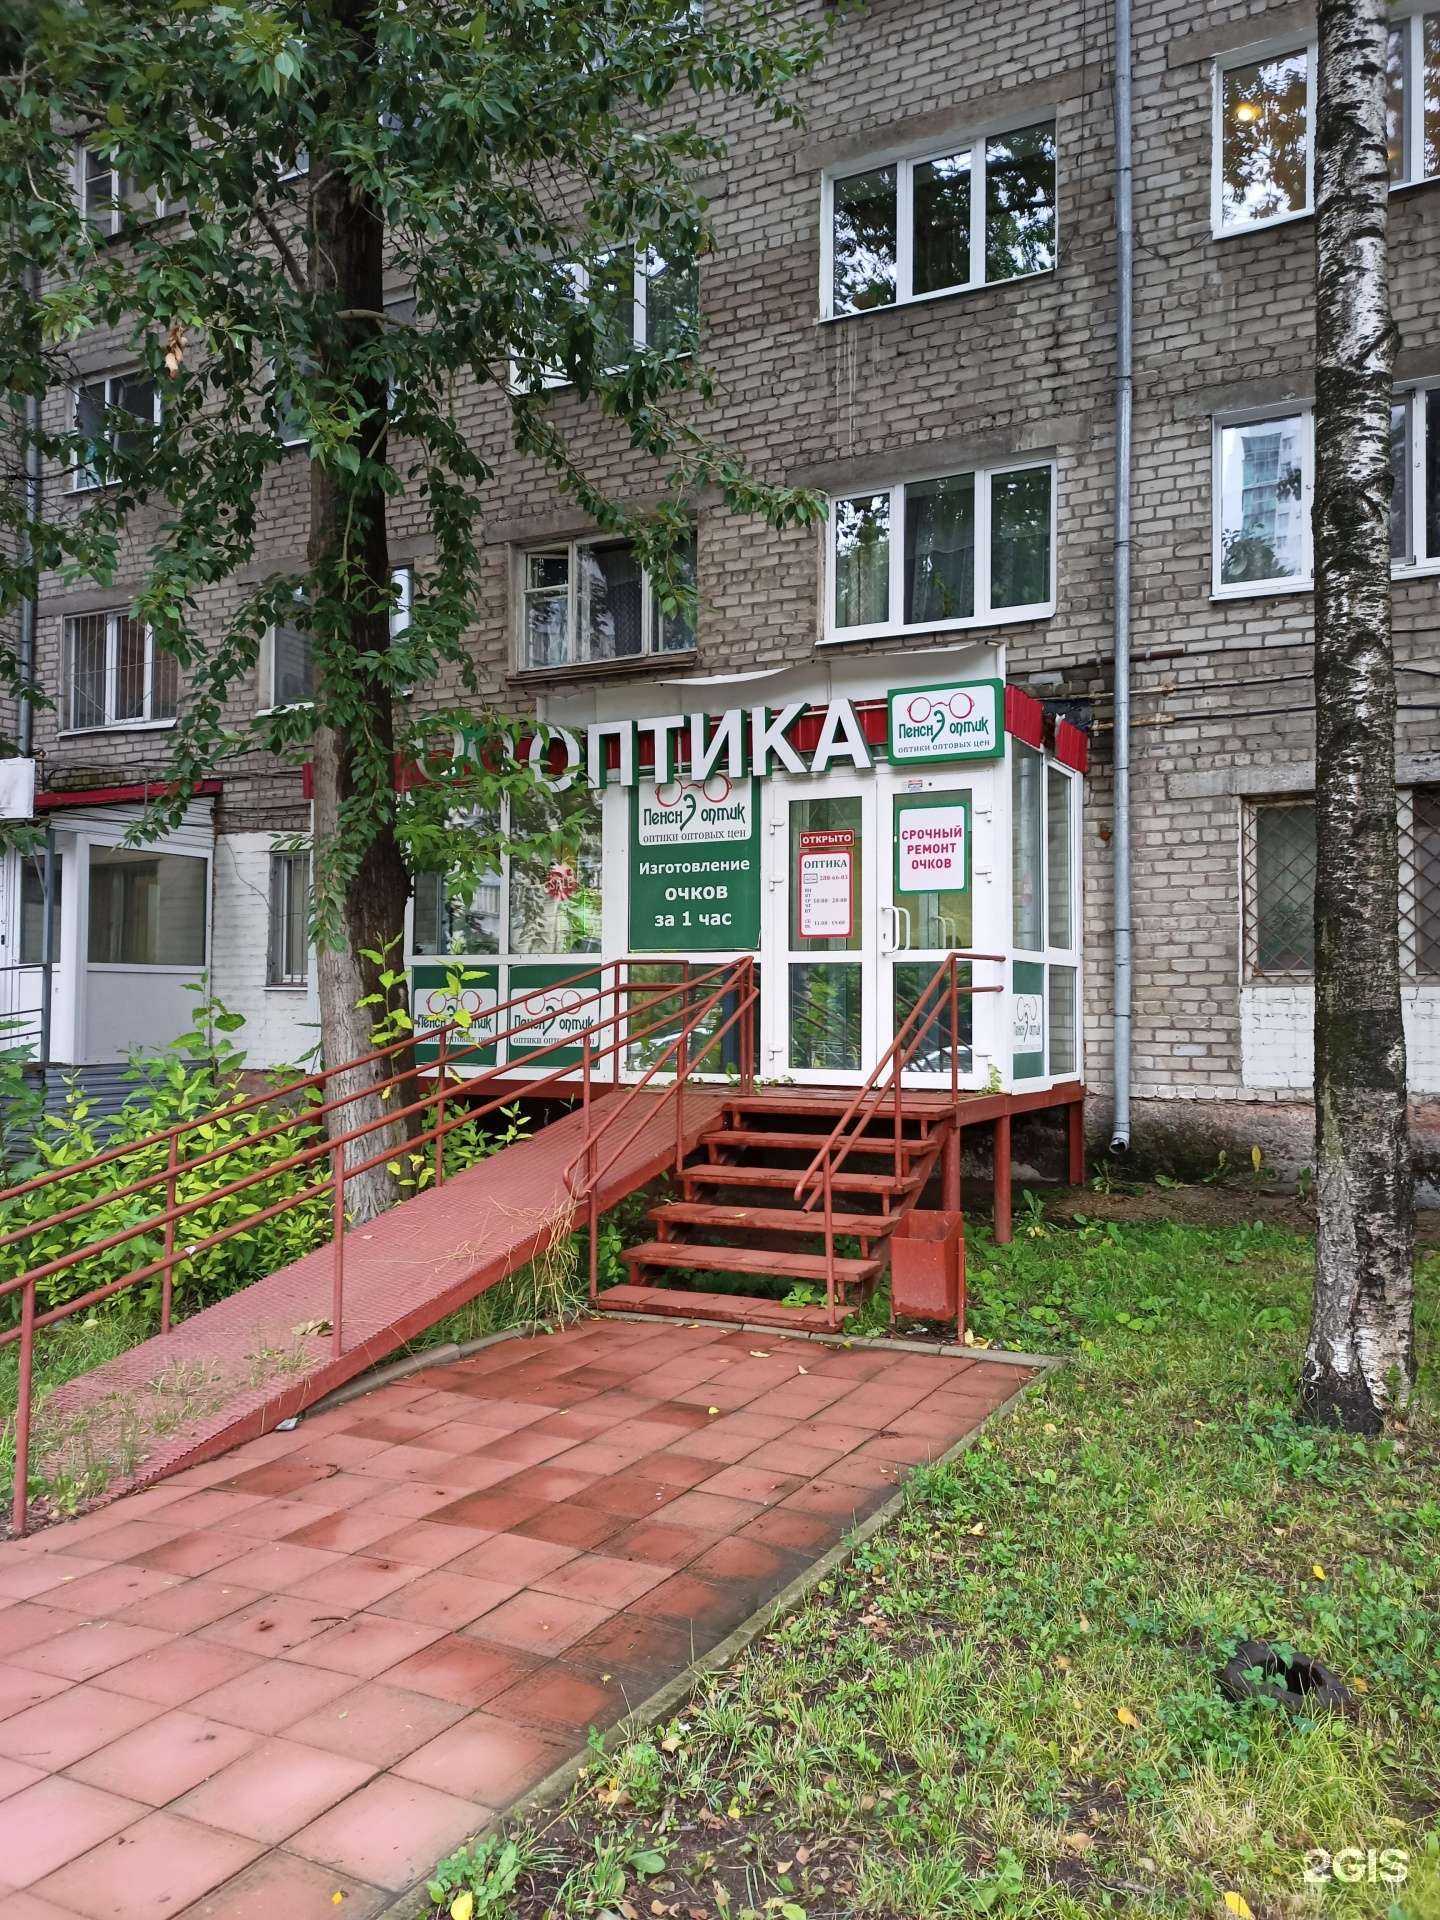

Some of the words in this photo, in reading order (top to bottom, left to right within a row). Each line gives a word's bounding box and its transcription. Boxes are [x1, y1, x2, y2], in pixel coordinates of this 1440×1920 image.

[949, 717, 989, 737] оптик
[529, 698, 877, 793] ОПТИКА
[898, 745, 930, 754] оптики
[932, 742, 971, 752] оптовых
[973, 739, 990, 749] цен
[701, 802, 746, 825] оптик
[643, 833, 679, 843] оптики
[681, 829, 725, 841] оптовых
[727, 829, 746, 839] цен
[802, 834, 852, 844] ОТКРЫТО
[901, 825, 963, 840] СРОЧНЫЙ
[907, 843, 957, 855] РЕМОНТ
[639, 859, 751, 875] Изготовление
[804, 859, 848, 869] ОПТИКА
[911, 859, 952, 870] ОЧКОВ
[665, 885, 729, 901] очков
[654, 914, 675, 927] за
[682, 911, 692, 926] 1
[699, 912, 732, 926] час
